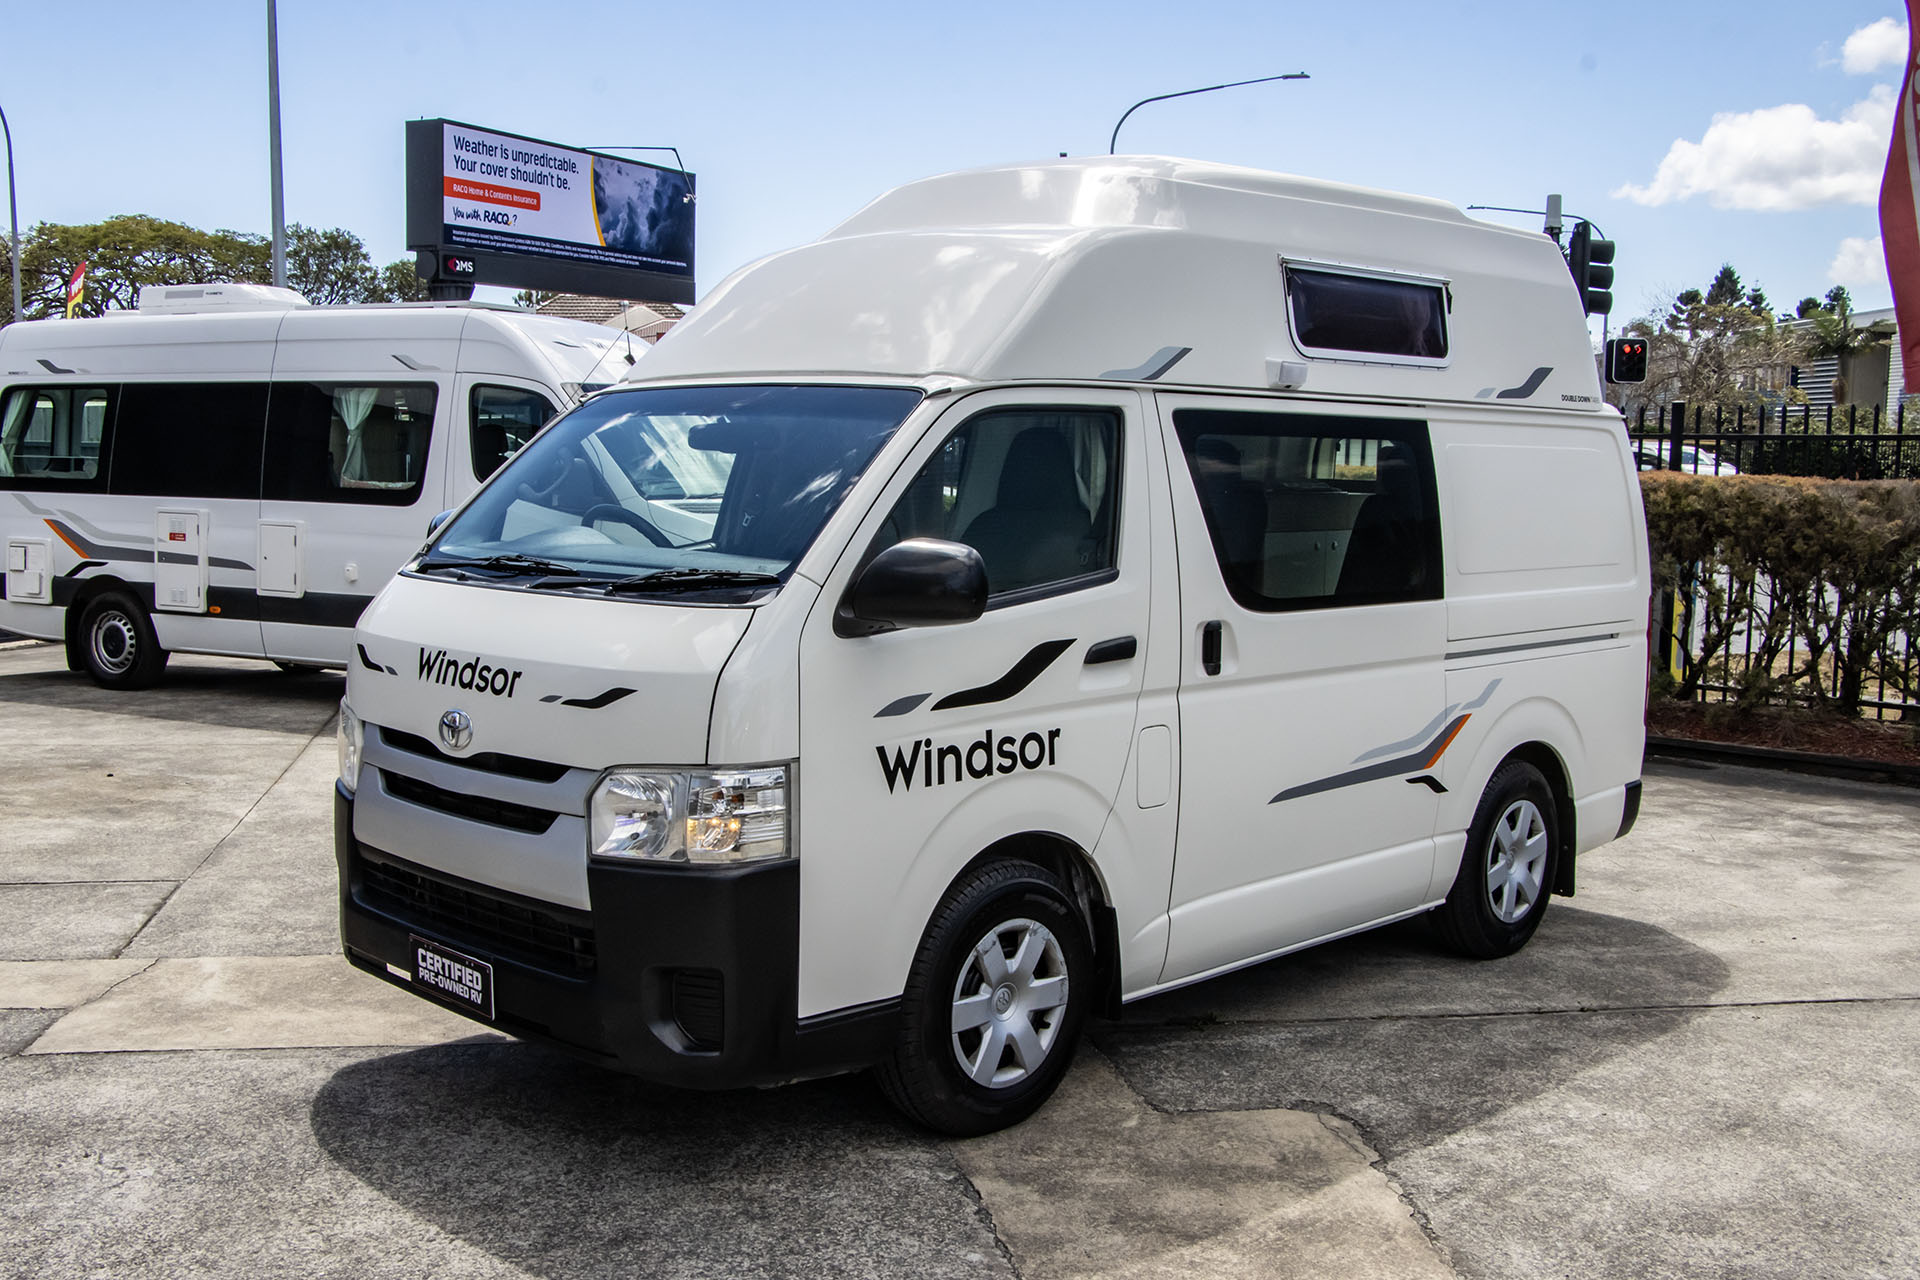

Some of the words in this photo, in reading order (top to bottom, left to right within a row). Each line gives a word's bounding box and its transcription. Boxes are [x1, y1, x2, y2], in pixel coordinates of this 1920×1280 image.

[453, 135, 498, 157] Weather
[500, 144, 509, 160] is
[511, 149, 579, 174] unpredictable.
[453, 155, 477, 172] Your
[480, 161, 508, 178] cover
[510, 166, 555, 188] shouldn't
[556, 174, 571, 190] be.
[453, 183, 468, 194] RACQ
[468, 186, 484, 197] Home
[489, 191, 513, 201] Contents
[513, 194, 537, 205] Insurance
[452, 206, 464, 221] You
[465, 208, 482, 221] with
[1561, 394, 1577, 402] DOUBLE
[1577, 395, 1591, 403] DOWN
[418, 647, 523, 698] Windsor
[875, 728, 1061, 795] Windsor
[418, 948, 482, 991] CERTIFIED
[418, 967, 469, 999] PRE-OWNED
[470, 989, 482, 1004] RV
